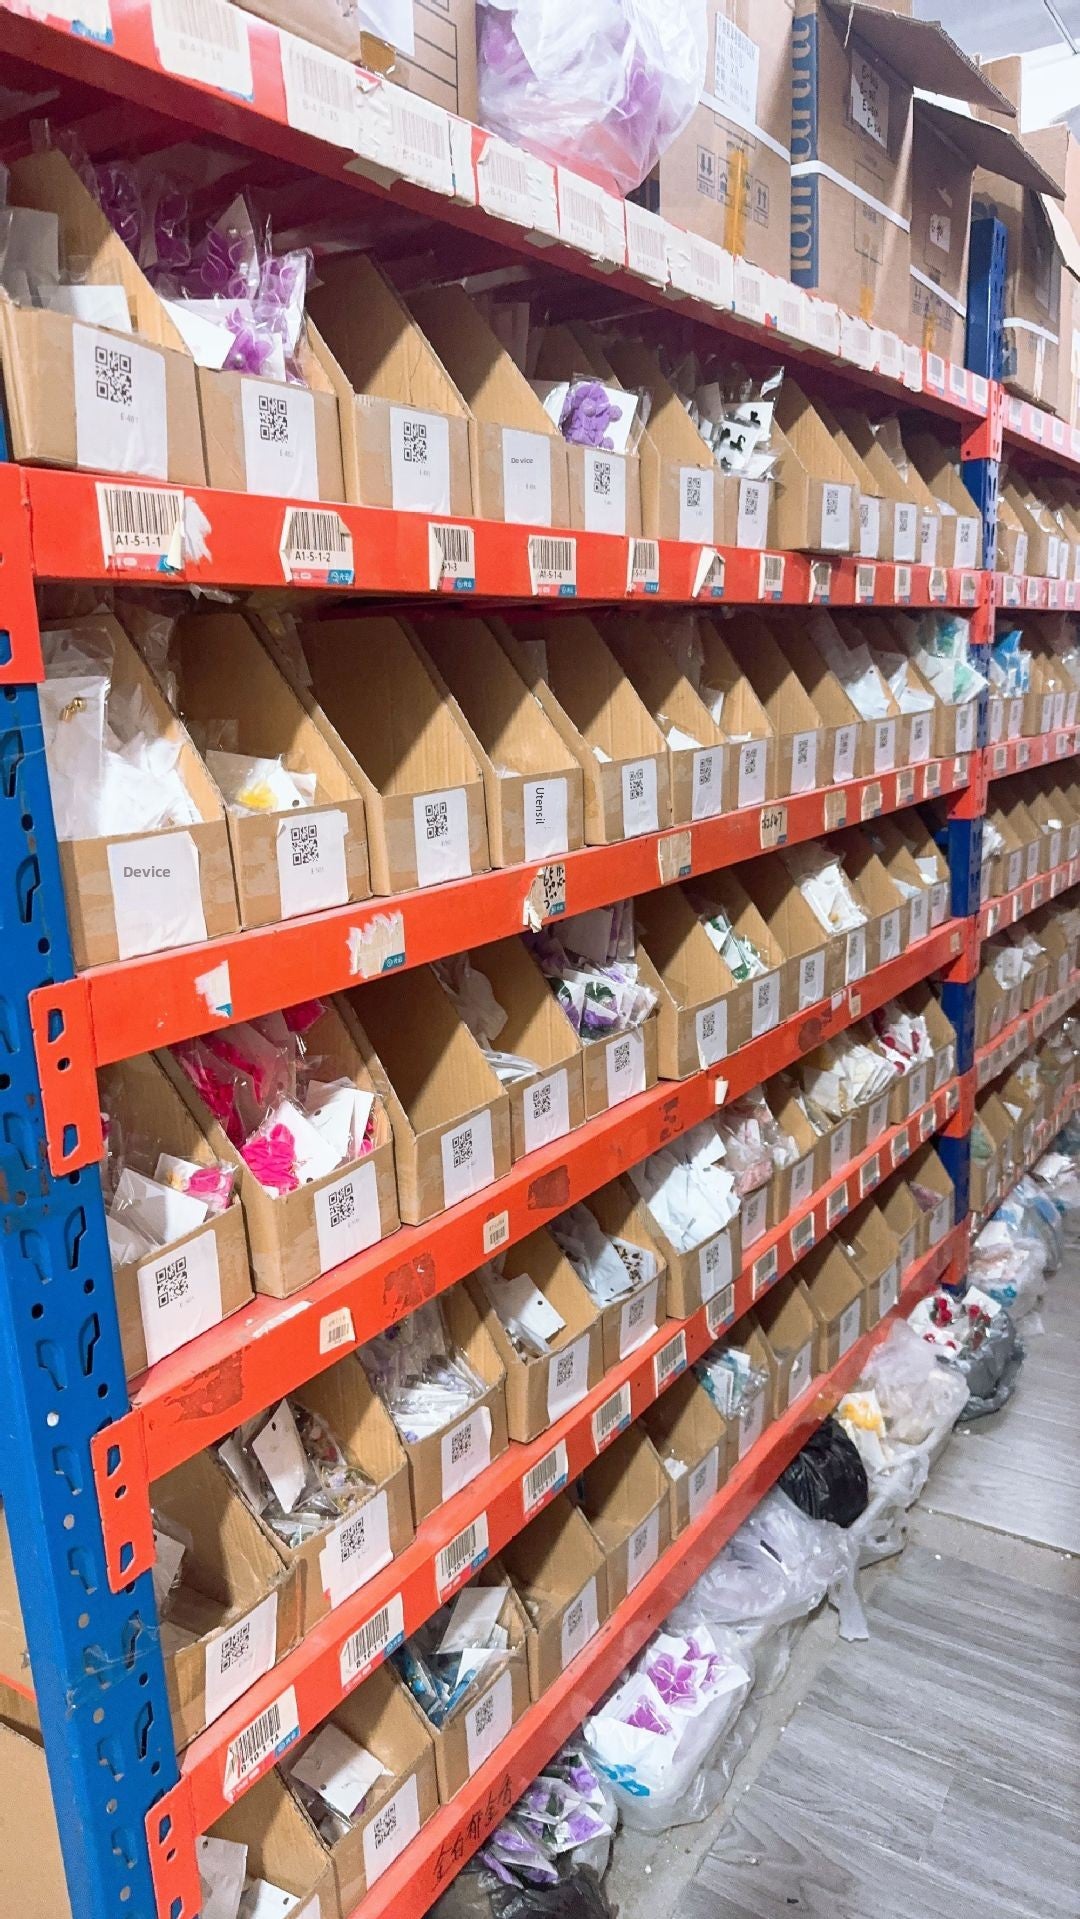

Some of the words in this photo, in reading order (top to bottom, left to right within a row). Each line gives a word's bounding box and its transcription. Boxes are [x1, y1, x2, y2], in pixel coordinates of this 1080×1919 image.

[115, 534, 161, 547] A1-5-1-1
[295, 550, 331, 562] A1-5-1-2
[535, 787, 546, 825] Utensil
[123, 865, 171, 878] Device
